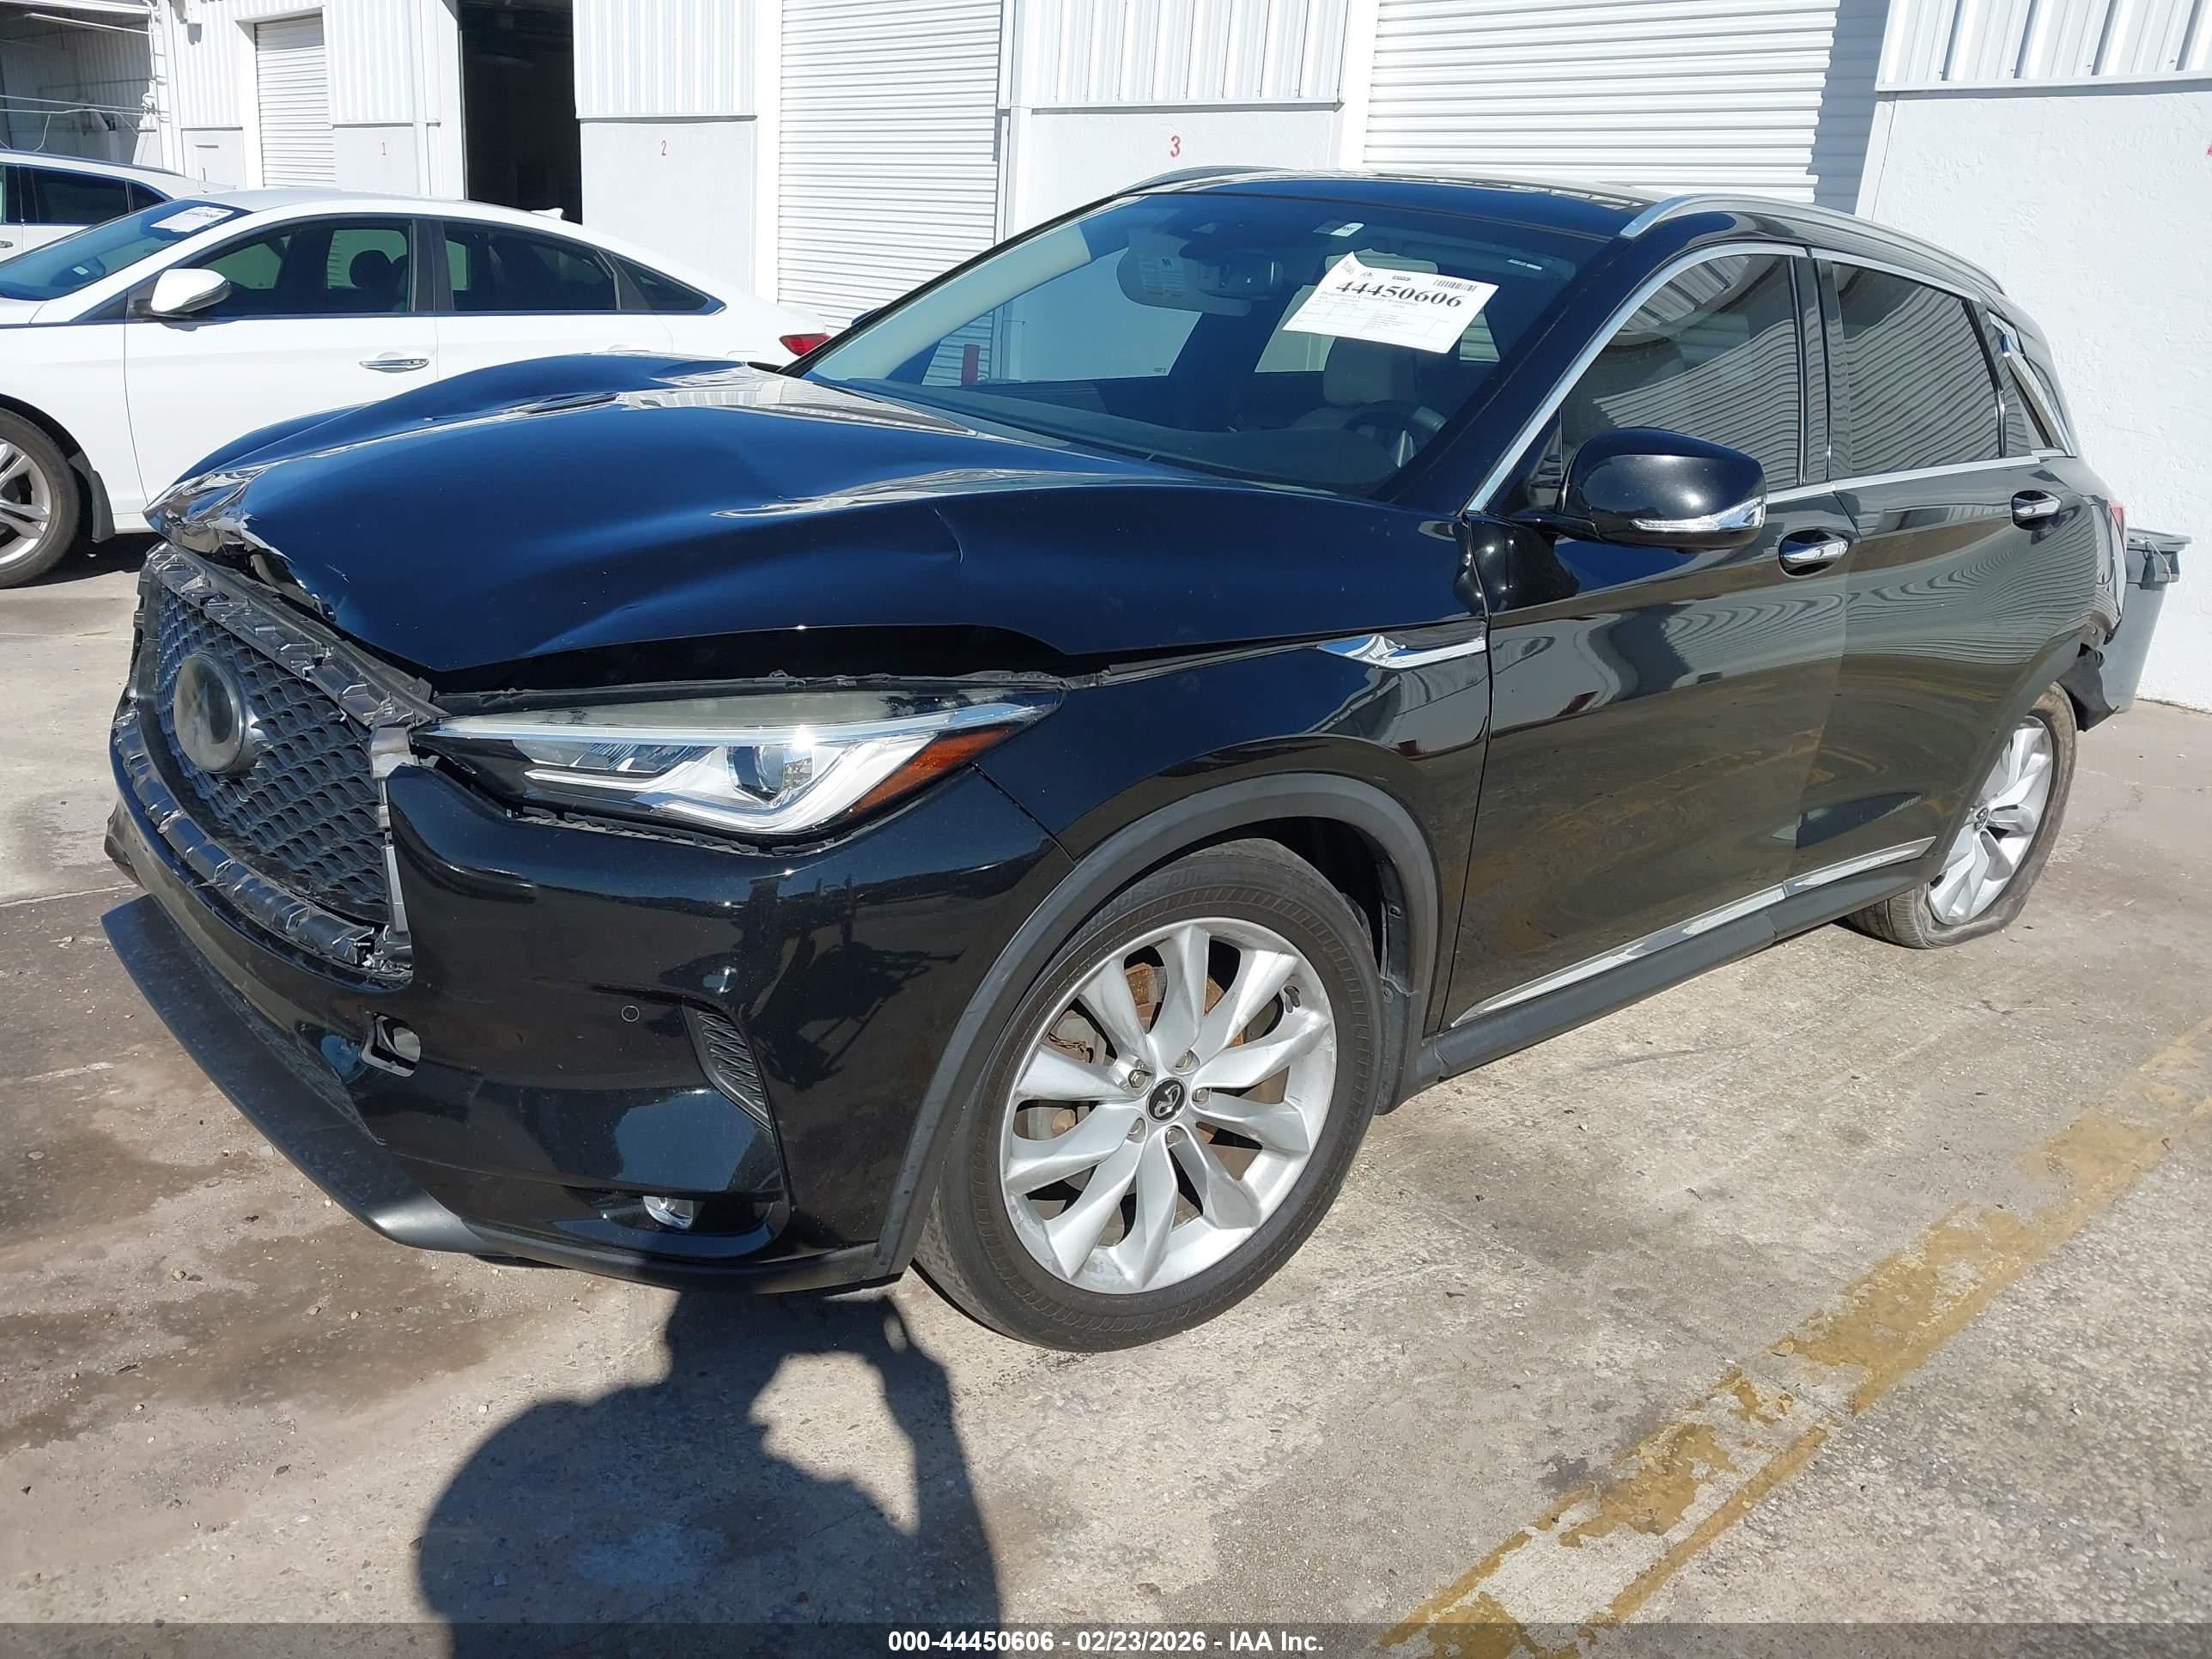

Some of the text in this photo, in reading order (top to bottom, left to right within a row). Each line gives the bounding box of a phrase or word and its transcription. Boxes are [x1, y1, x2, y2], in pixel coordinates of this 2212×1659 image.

[381, 141, 387, 156] 1
[661, 140, 667, 156] 2
[1170, 135, 1181, 158] 3
[1336, 281, 1465, 307] 44450606
